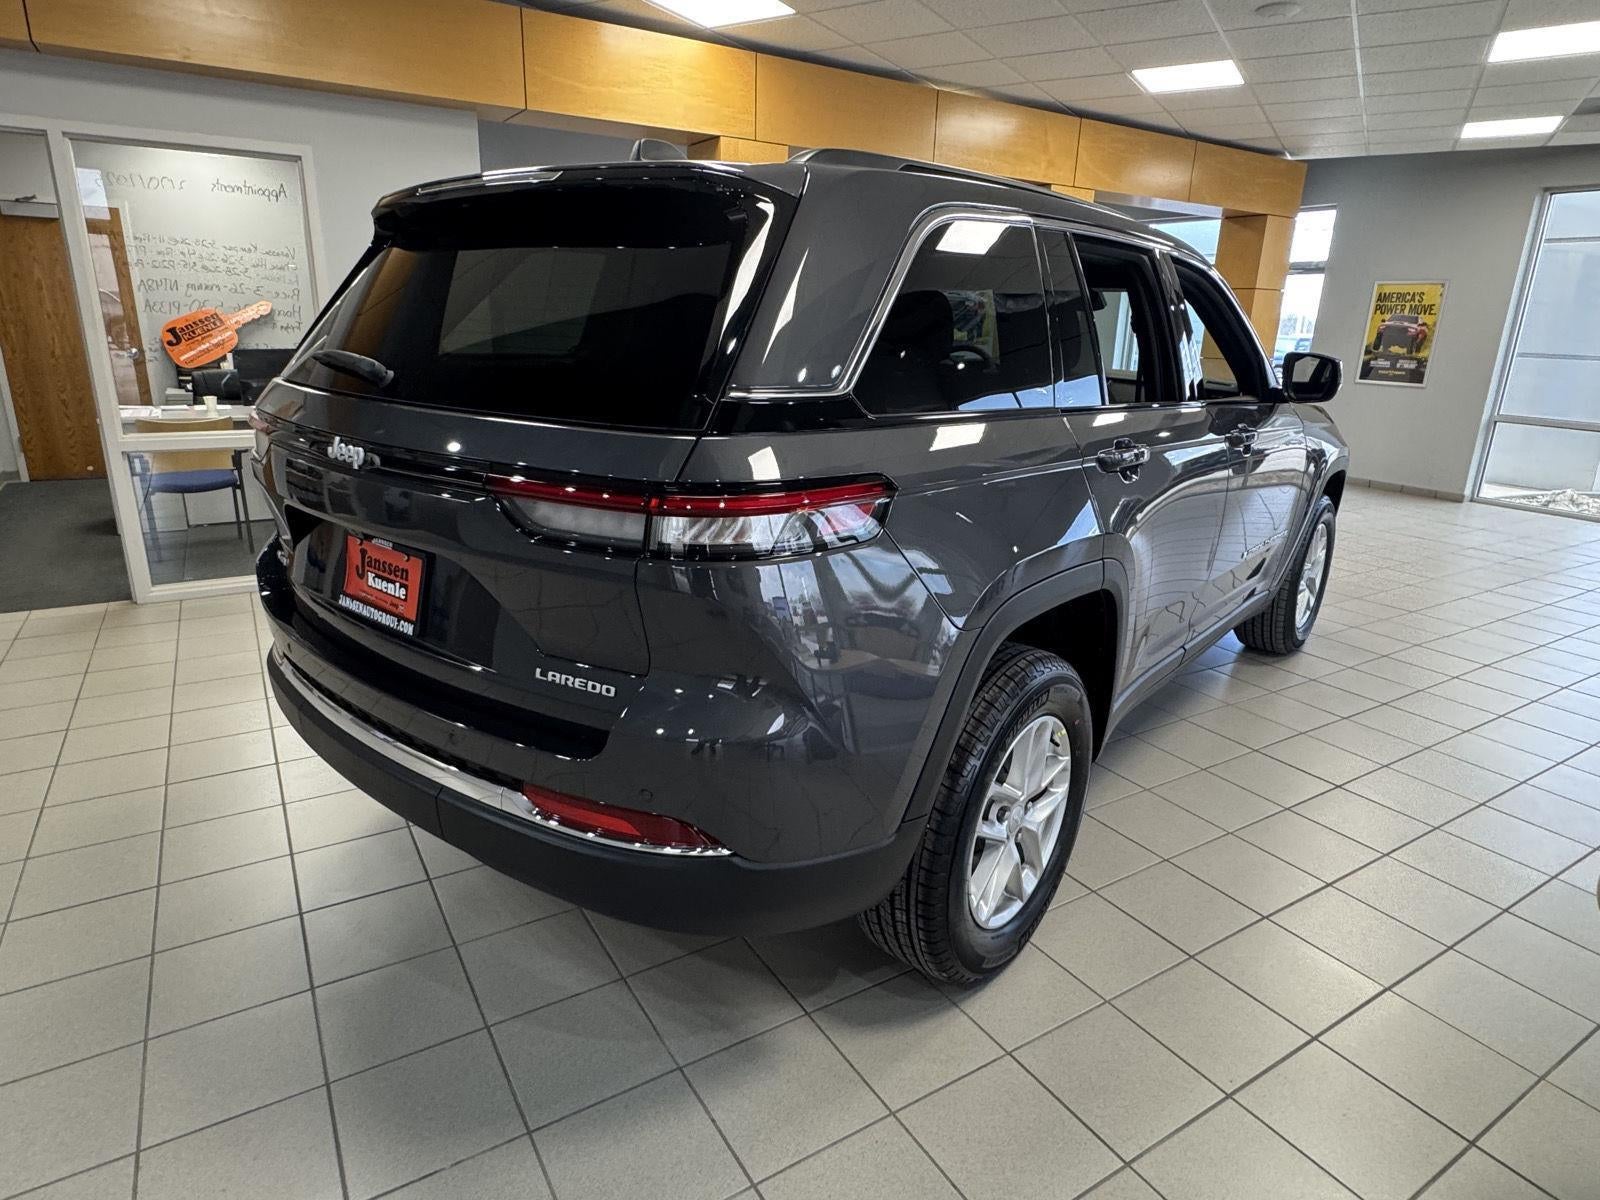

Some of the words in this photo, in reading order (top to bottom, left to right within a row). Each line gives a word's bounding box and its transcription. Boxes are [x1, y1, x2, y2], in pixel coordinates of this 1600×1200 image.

[1374, 304, 1406, 315] POWER
[1407, 304, 1437, 315] MOVE.
[1375, 292, 1425, 303] AMERICA'S
[166, 312, 221, 347] Janssen
[327, 436, 365, 469] Jeep
[356, 547, 410, 582] Janssen
[367, 572, 407, 600] Kuenle
[535, 667, 616, 698] LAREDO
